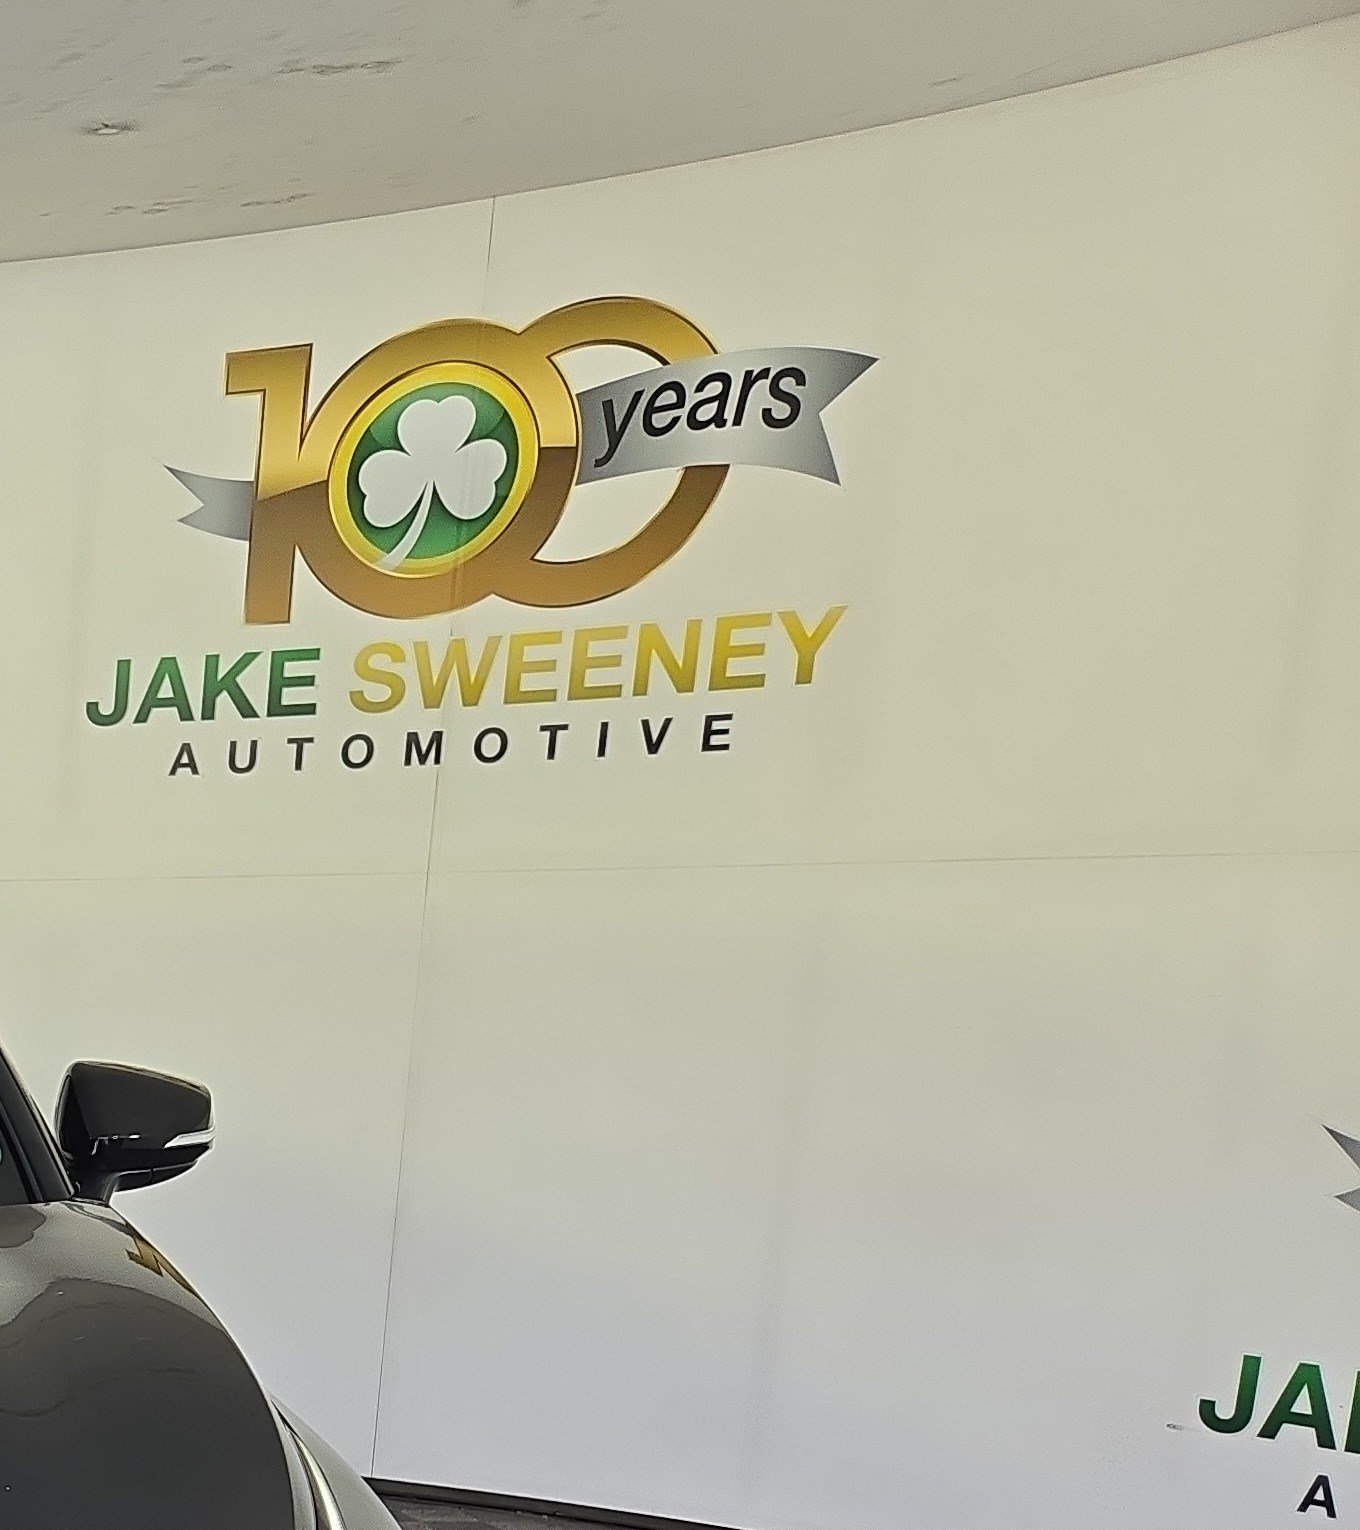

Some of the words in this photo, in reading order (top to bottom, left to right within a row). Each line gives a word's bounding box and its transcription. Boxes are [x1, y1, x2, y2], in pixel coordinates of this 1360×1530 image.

[593, 363, 807, 468] years
[85, 647, 322, 728] JAKE
[348, 605, 848, 715] SWEENEY
[168, 713, 734, 778] AUTOMOTIVE
